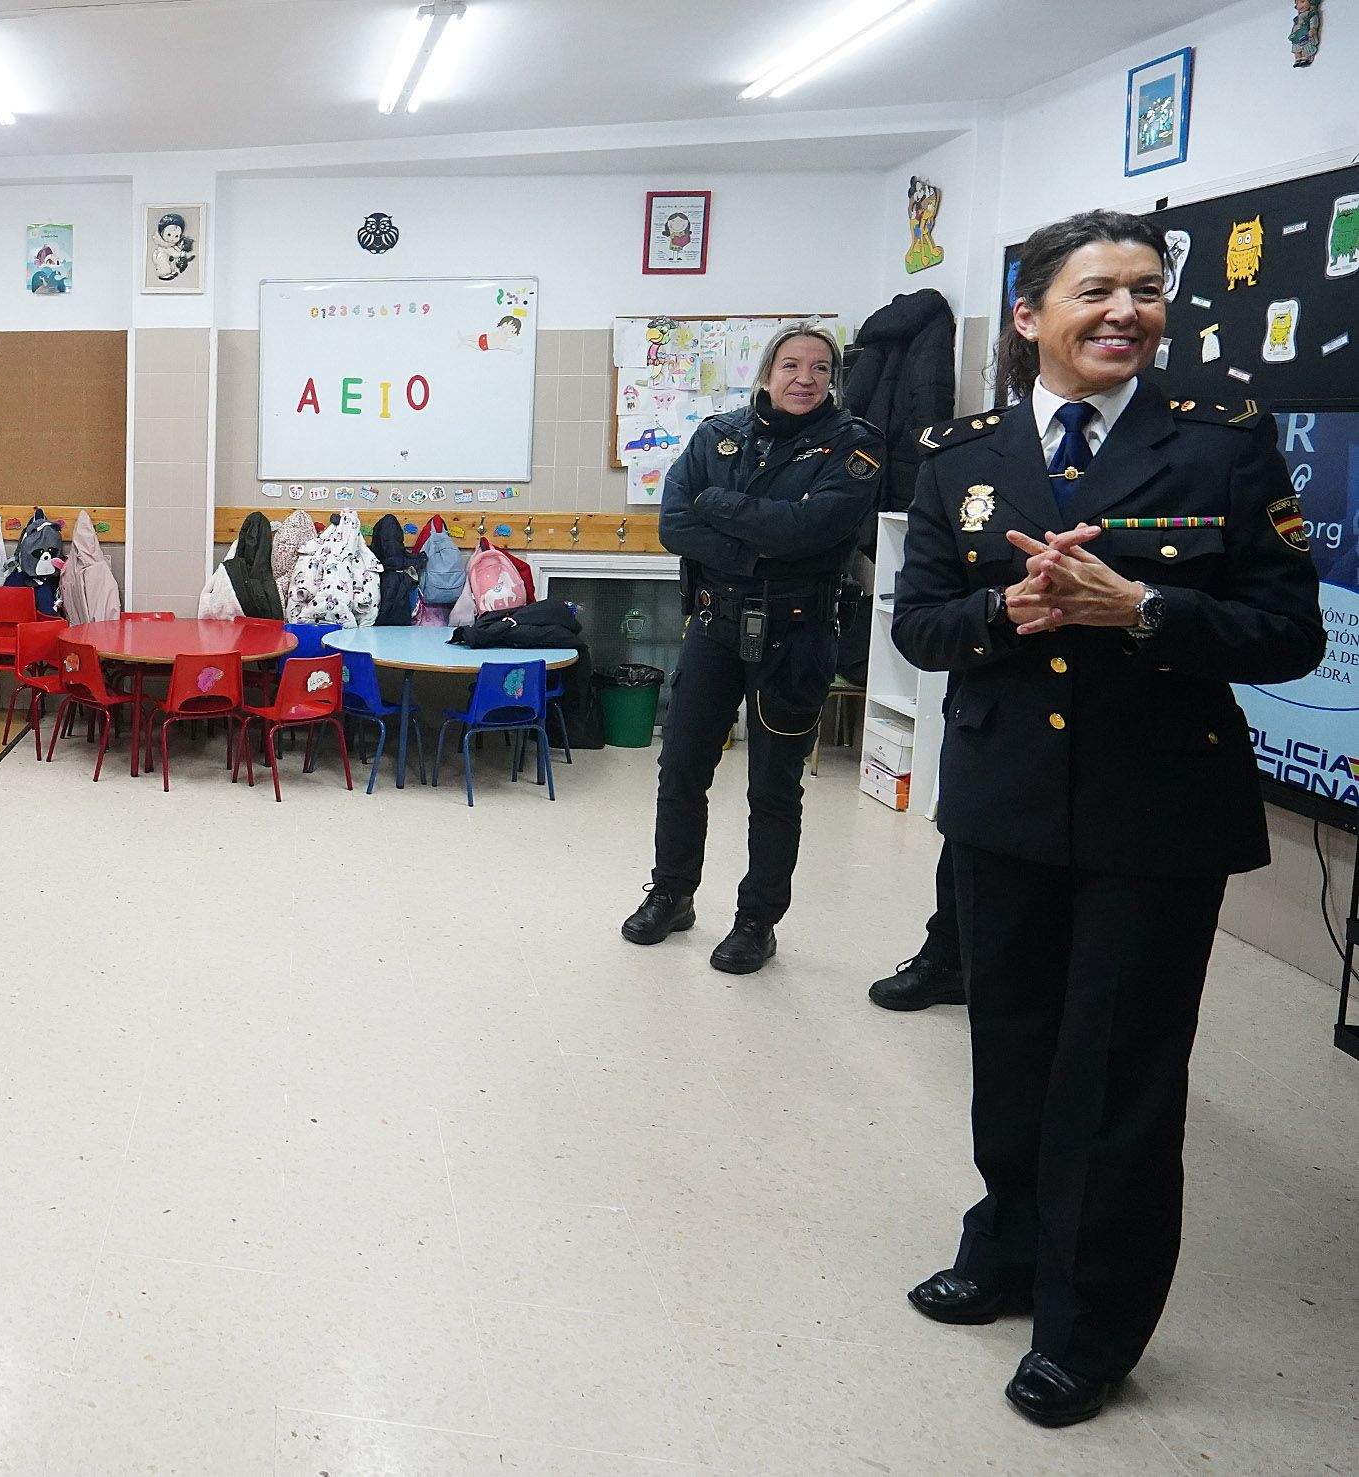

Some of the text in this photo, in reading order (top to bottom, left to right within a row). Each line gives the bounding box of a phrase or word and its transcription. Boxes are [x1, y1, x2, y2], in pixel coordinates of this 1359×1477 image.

[296, 374, 430, 419] A E I O
[1272, 412, 1315, 453] R
[1302, 520, 1342, 549] org
[1325, 629, 1359, 647] CIÓN
